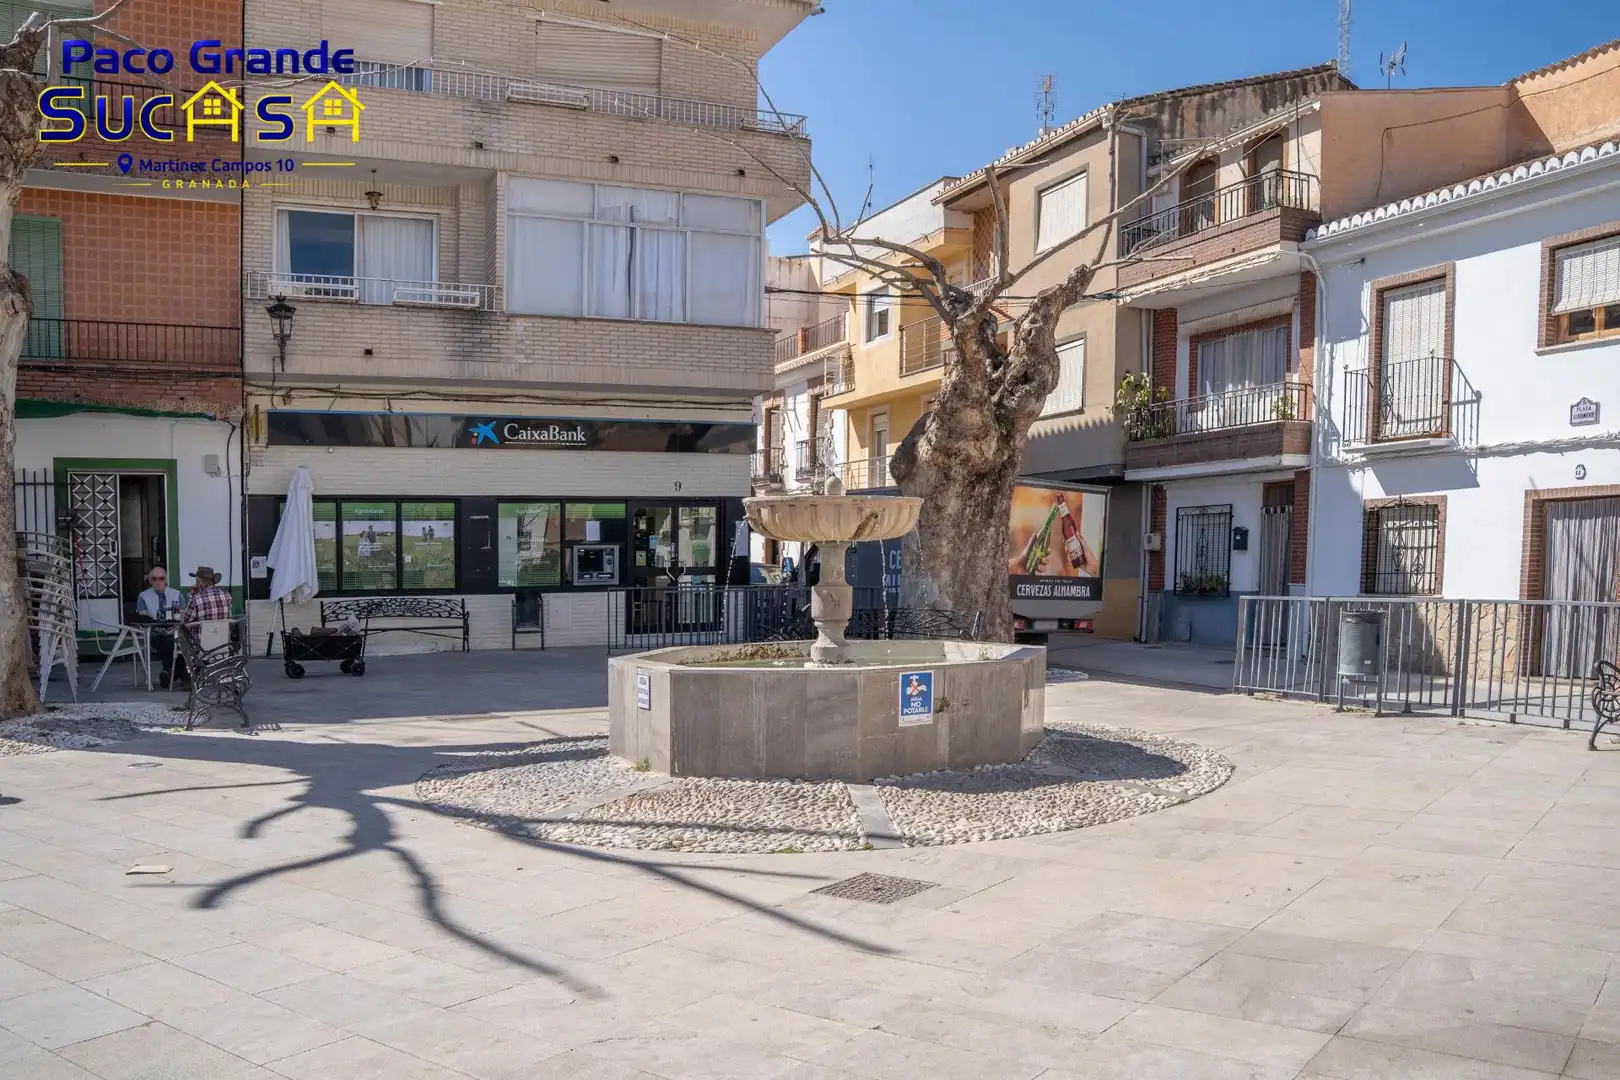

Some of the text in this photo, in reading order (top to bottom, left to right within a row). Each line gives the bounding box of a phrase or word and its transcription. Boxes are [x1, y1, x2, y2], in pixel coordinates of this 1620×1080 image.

[503, 423, 587, 441] CaixaBank
[674, 480, 682, 491] 9
[1016, 584, 1091, 598] CERVEZAS ALHAMBRA
[903, 706, 929, 714] POTABLE
